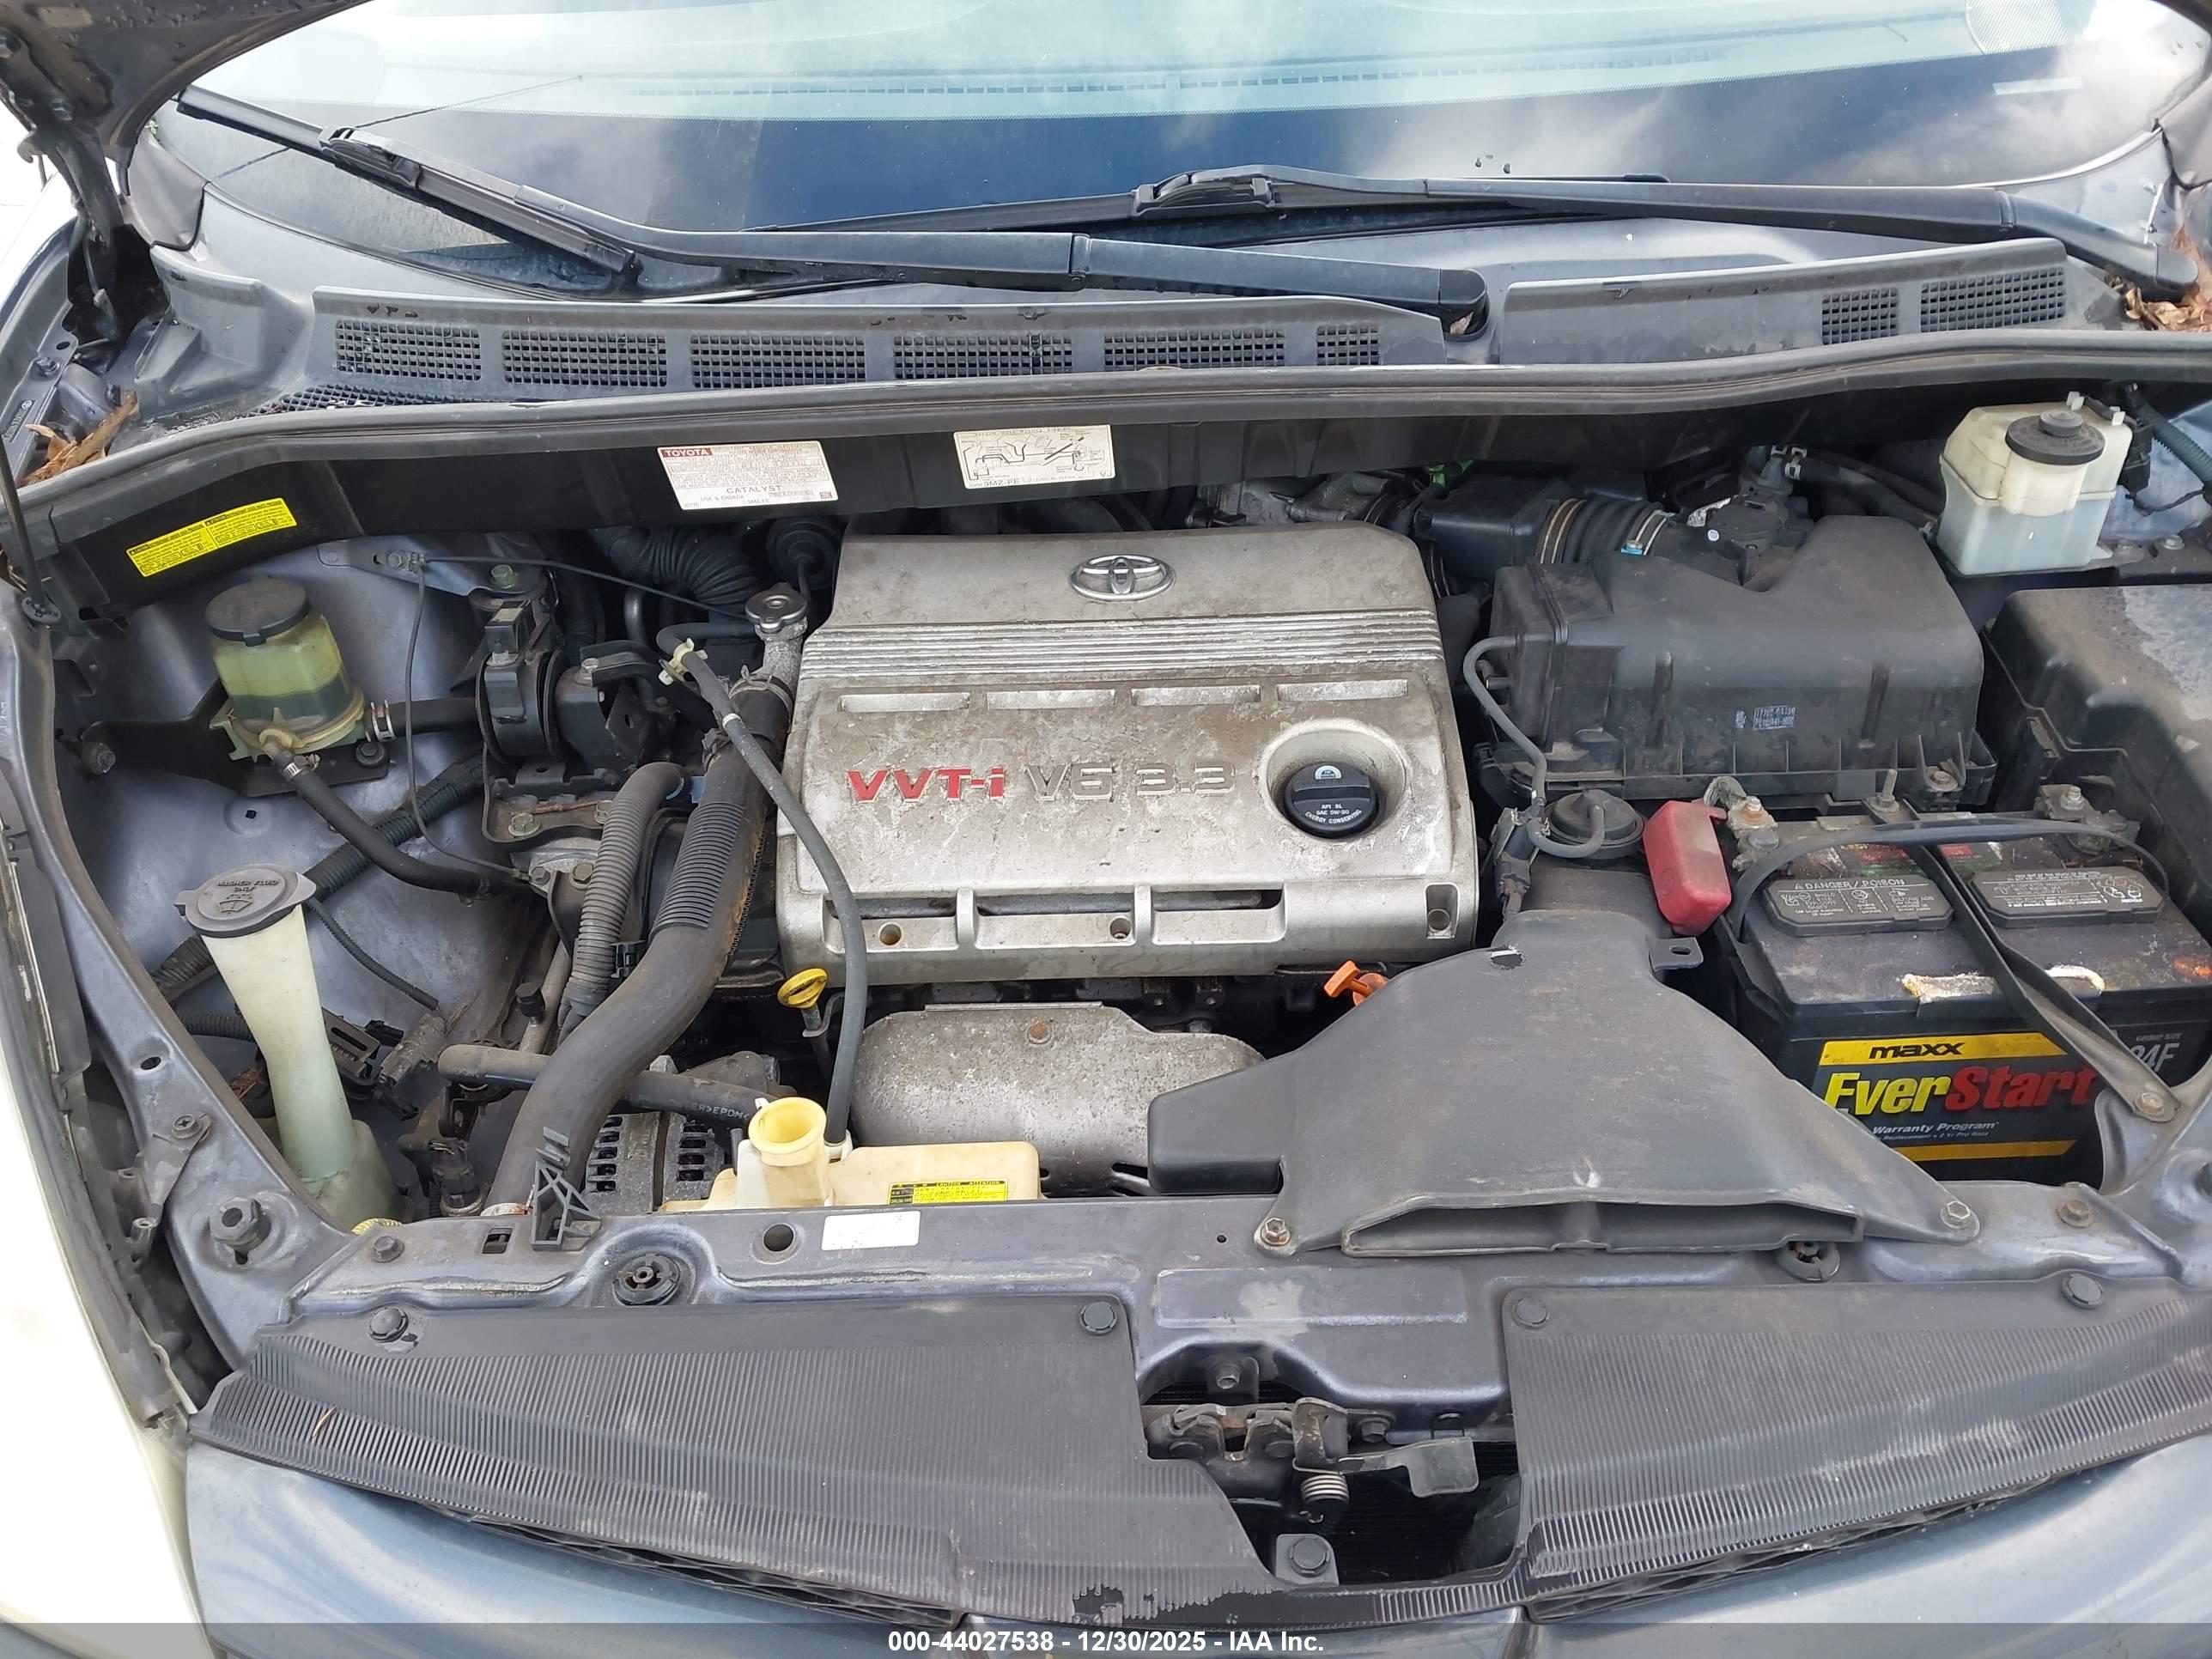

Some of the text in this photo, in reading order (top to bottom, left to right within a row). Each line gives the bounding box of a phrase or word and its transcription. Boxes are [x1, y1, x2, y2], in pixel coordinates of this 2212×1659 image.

[665, 449, 709, 458] TOYOTA
[726, 484, 783, 495] CATALYST
[848, 763, 1237, 803] VVT-i V6 3.3
[1304, 809, 1363, 824] ENERGY CONSERVING
[1805, 881, 1852, 890] DANGER
[1861, 878, 1905, 890] POISON
[2136, 1032, 2183, 1042] GROUP SIZE
[1869, 1042, 1966, 1060] maxx
[1823, 1065, 2098, 1116] EverStart
[1873, 1124, 1935, 1133] Warranty
